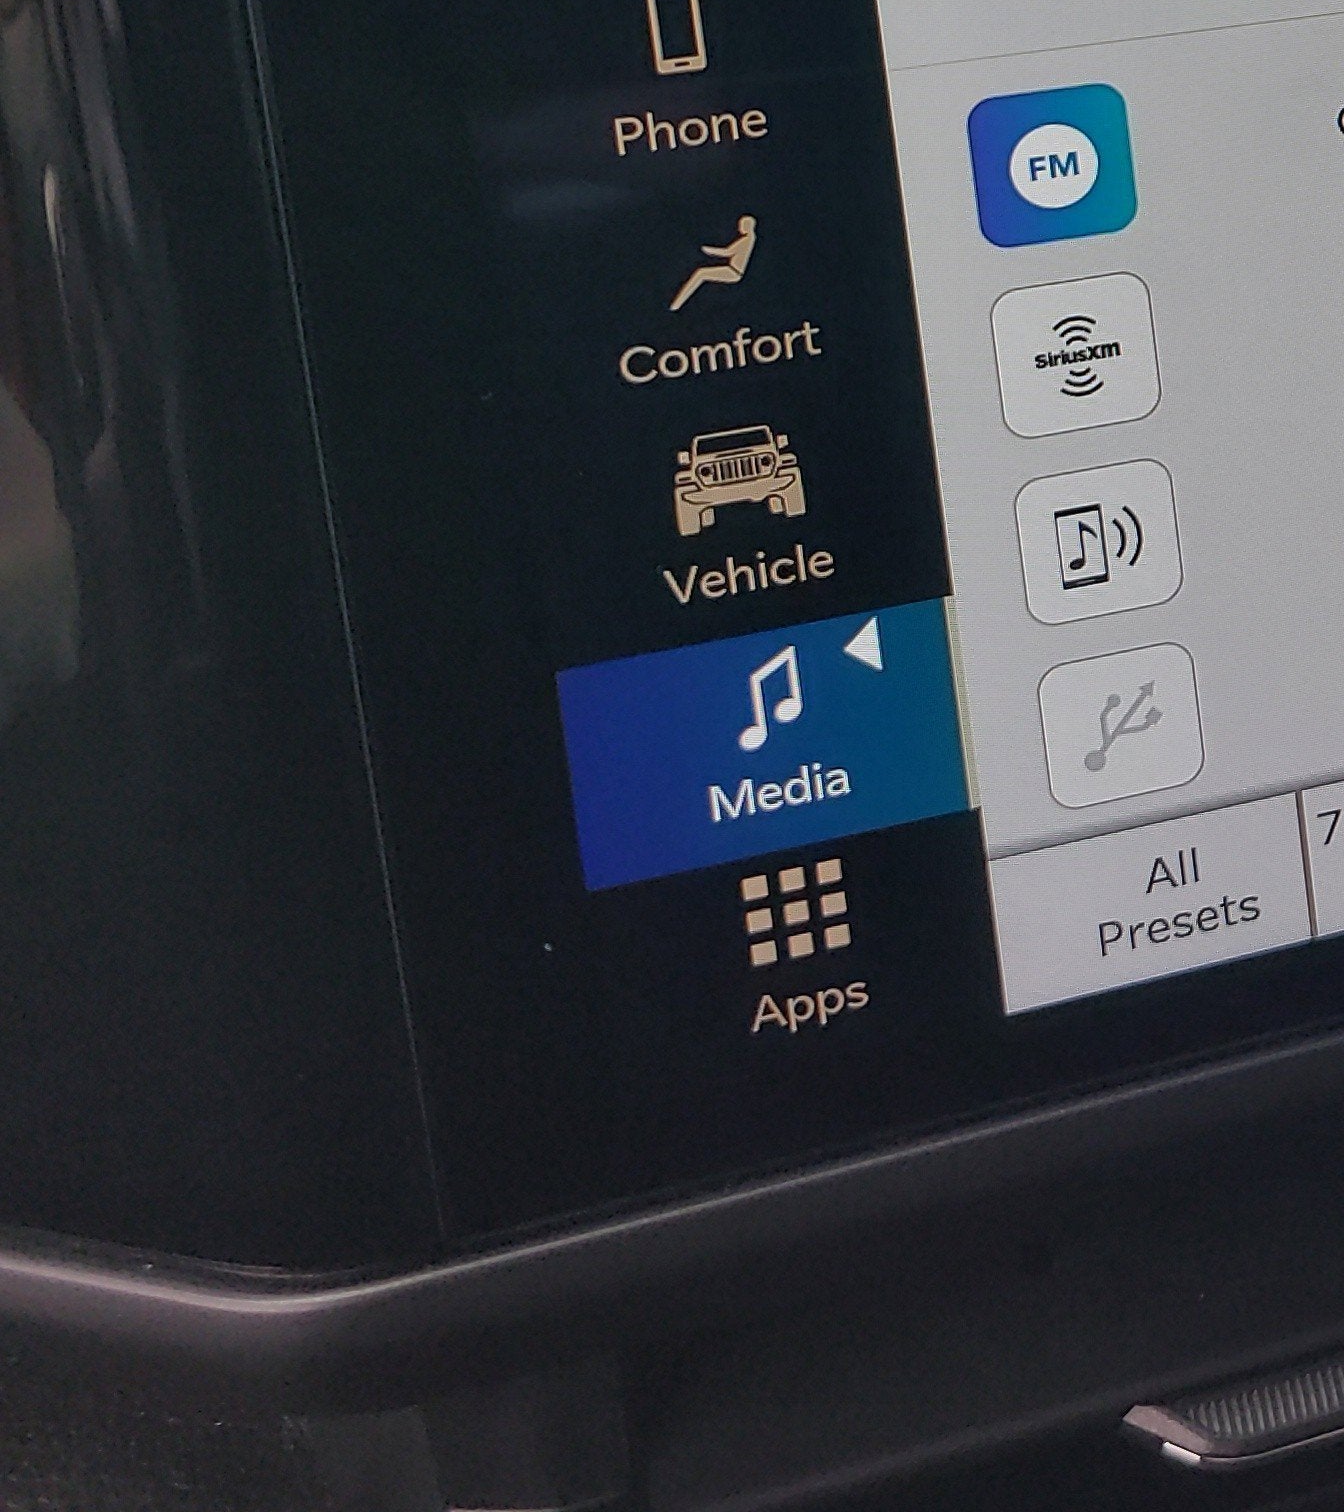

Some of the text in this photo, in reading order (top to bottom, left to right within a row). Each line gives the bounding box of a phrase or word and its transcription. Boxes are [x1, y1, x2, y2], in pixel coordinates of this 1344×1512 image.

[611, 106, 769, 157] Phone
[1028, 151, 1080, 182] FM
[618, 321, 822, 386] Comfort
[664, 543, 836, 605] Vehicle
[708, 763, 852, 823] Media
[1316, 808, 1343, 846] 7
[1145, 846, 1201, 895] All
[1097, 892, 1262, 957] Presets
[750, 978, 870, 1034] Apps
